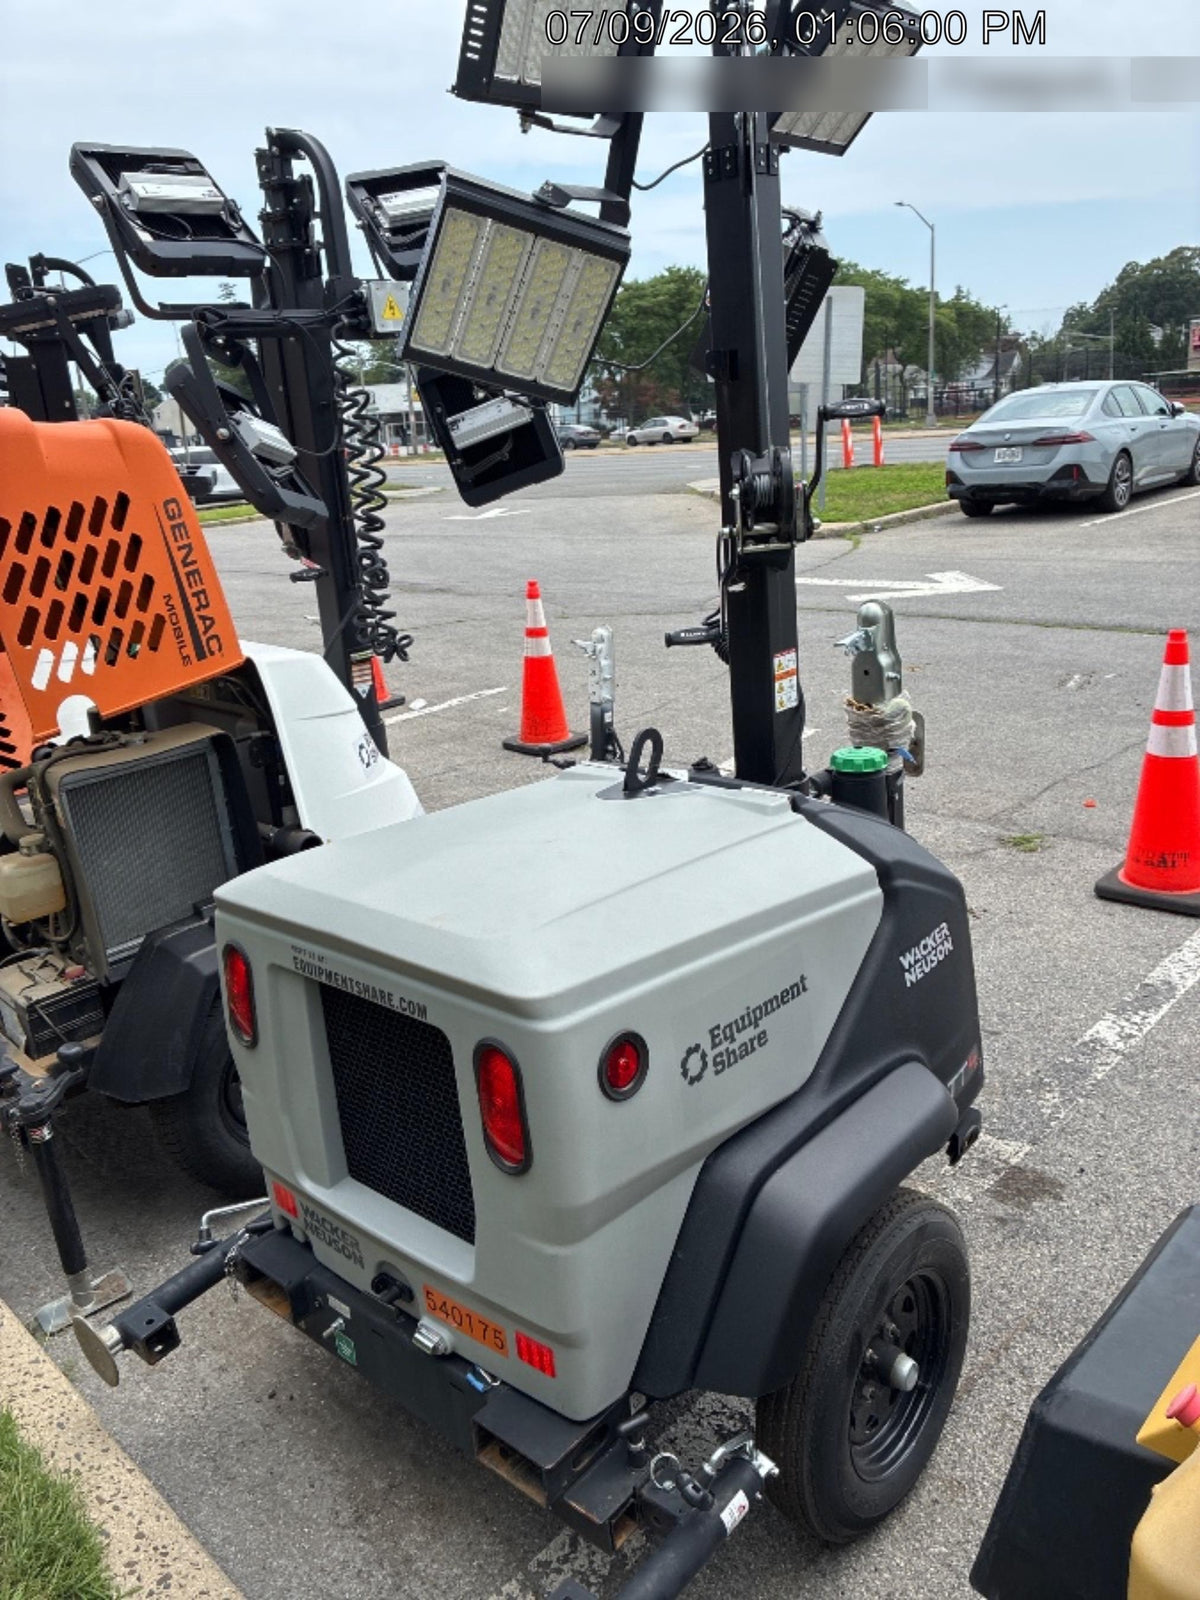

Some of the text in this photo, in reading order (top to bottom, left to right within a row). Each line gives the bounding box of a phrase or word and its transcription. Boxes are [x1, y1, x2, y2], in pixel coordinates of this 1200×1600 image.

[163, 497, 223, 657] GENERAC
[163, 593, 193, 668] MOBILE
[899, 921, 950, 970] WACKER
[904, 937, 954, 988] NEUSON
[292, 955, 428, 1021] EQUIPMENTSHARE.COM
[708, 973, 808, 1051] Equipment
[712, 1028, 769, 1077] Share
[300, 1201, 361, 1255] WACKER
[303, 1215, 365, 1271] NEUSON
[425, 1289, 505, 1351] 540175
